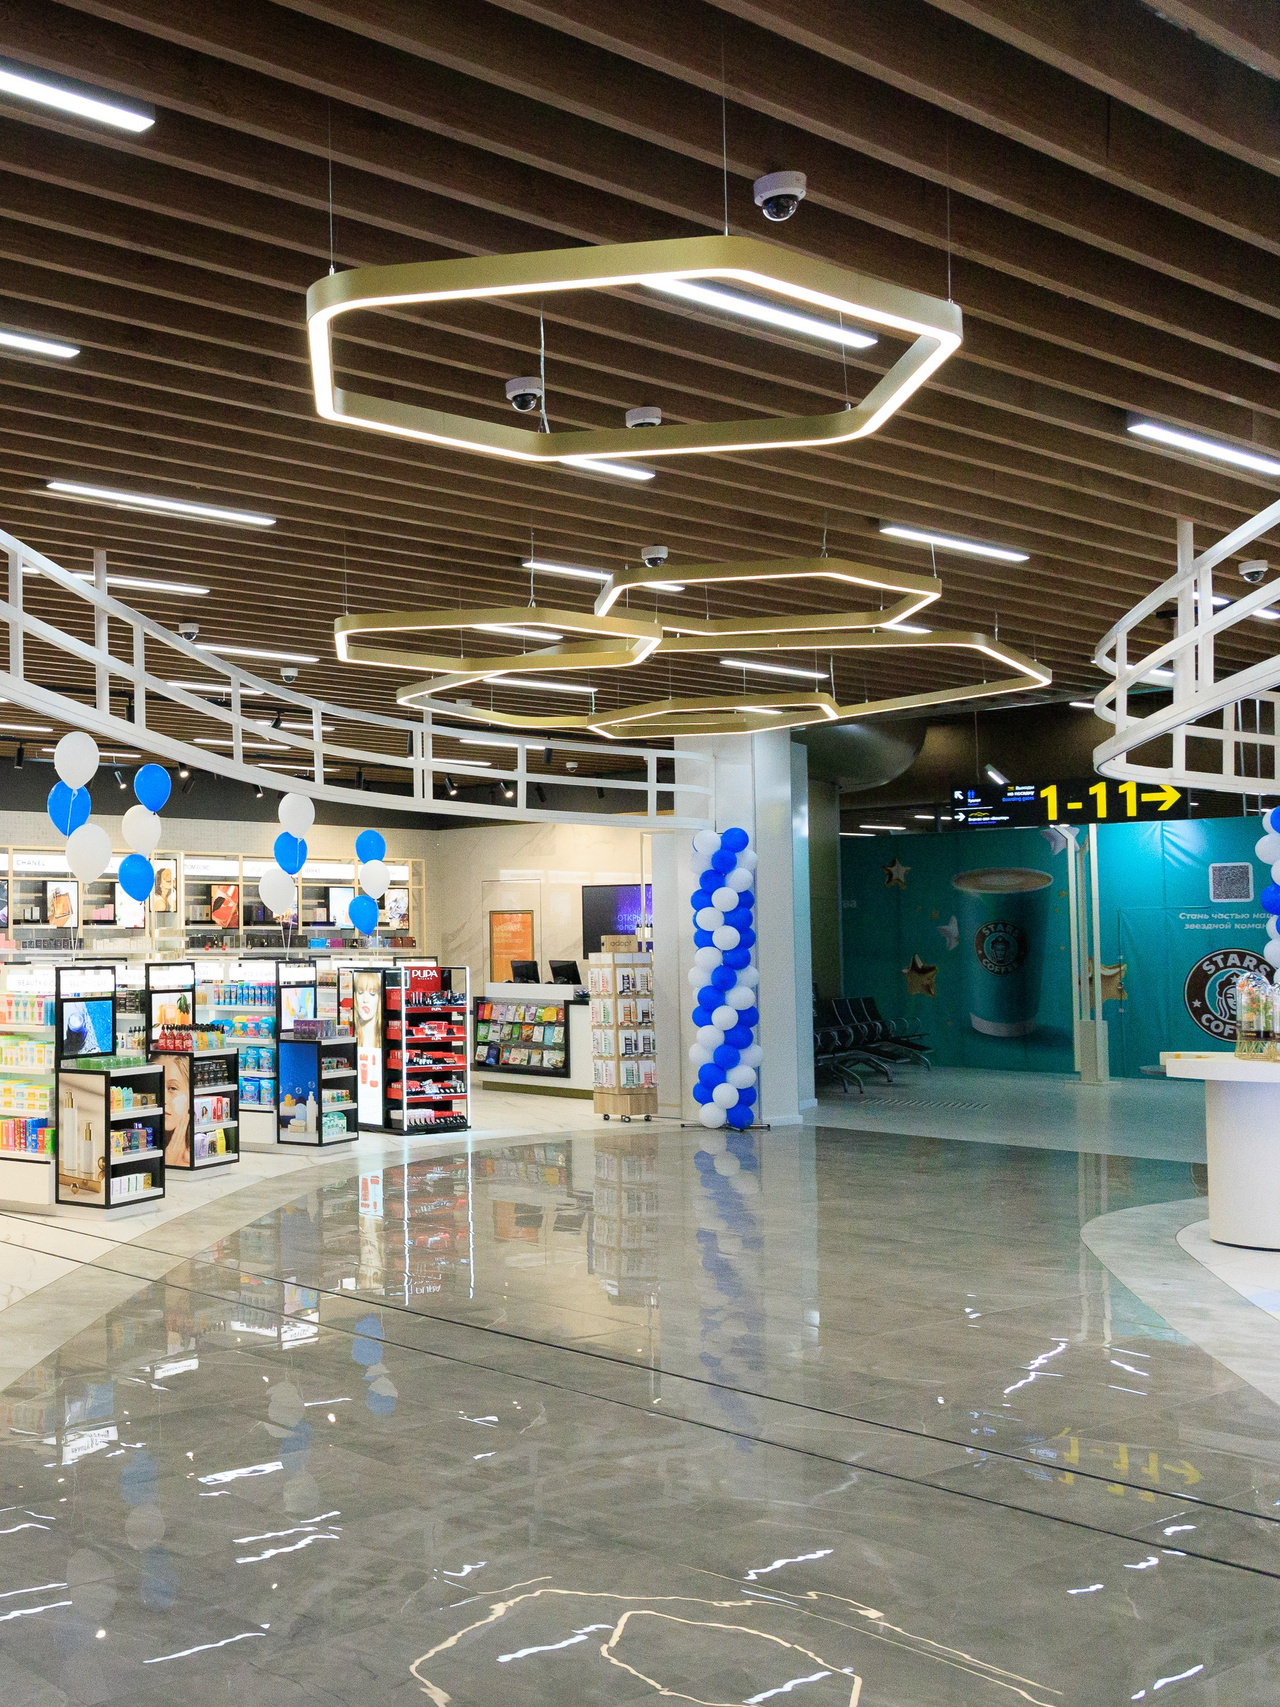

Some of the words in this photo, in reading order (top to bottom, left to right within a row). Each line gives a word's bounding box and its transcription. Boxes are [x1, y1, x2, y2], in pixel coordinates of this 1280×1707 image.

[16, 859, 46, 867] CHANEL
[1184, 922, 1232, 930] звездной
[1202, 954, 1271, 976] STARS
[412, 969, 439, 978] PUPA
